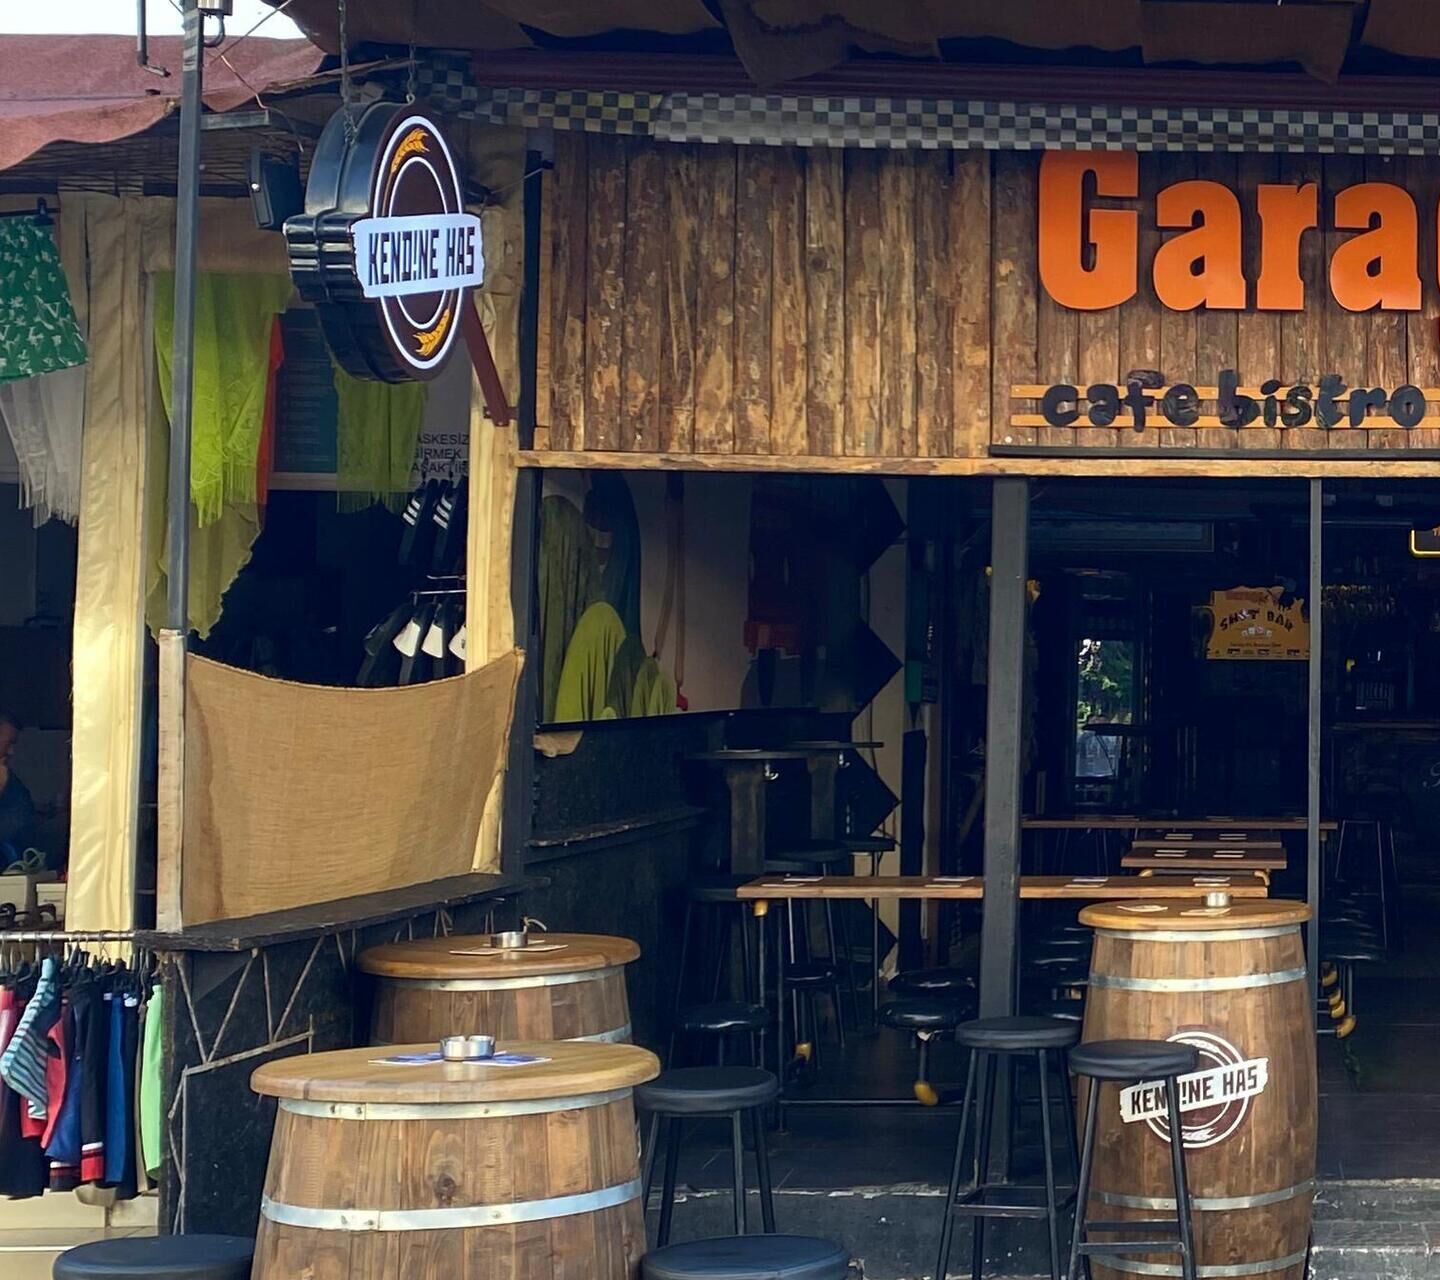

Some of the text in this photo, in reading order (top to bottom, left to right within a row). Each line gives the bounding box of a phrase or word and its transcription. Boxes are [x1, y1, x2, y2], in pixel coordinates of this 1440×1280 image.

[446, 226, 475, 277] HAS
[1042, 369, 1426, 433] cafe bistro
[1131, 1066, 1257, 1115] KEN!NE HAS
